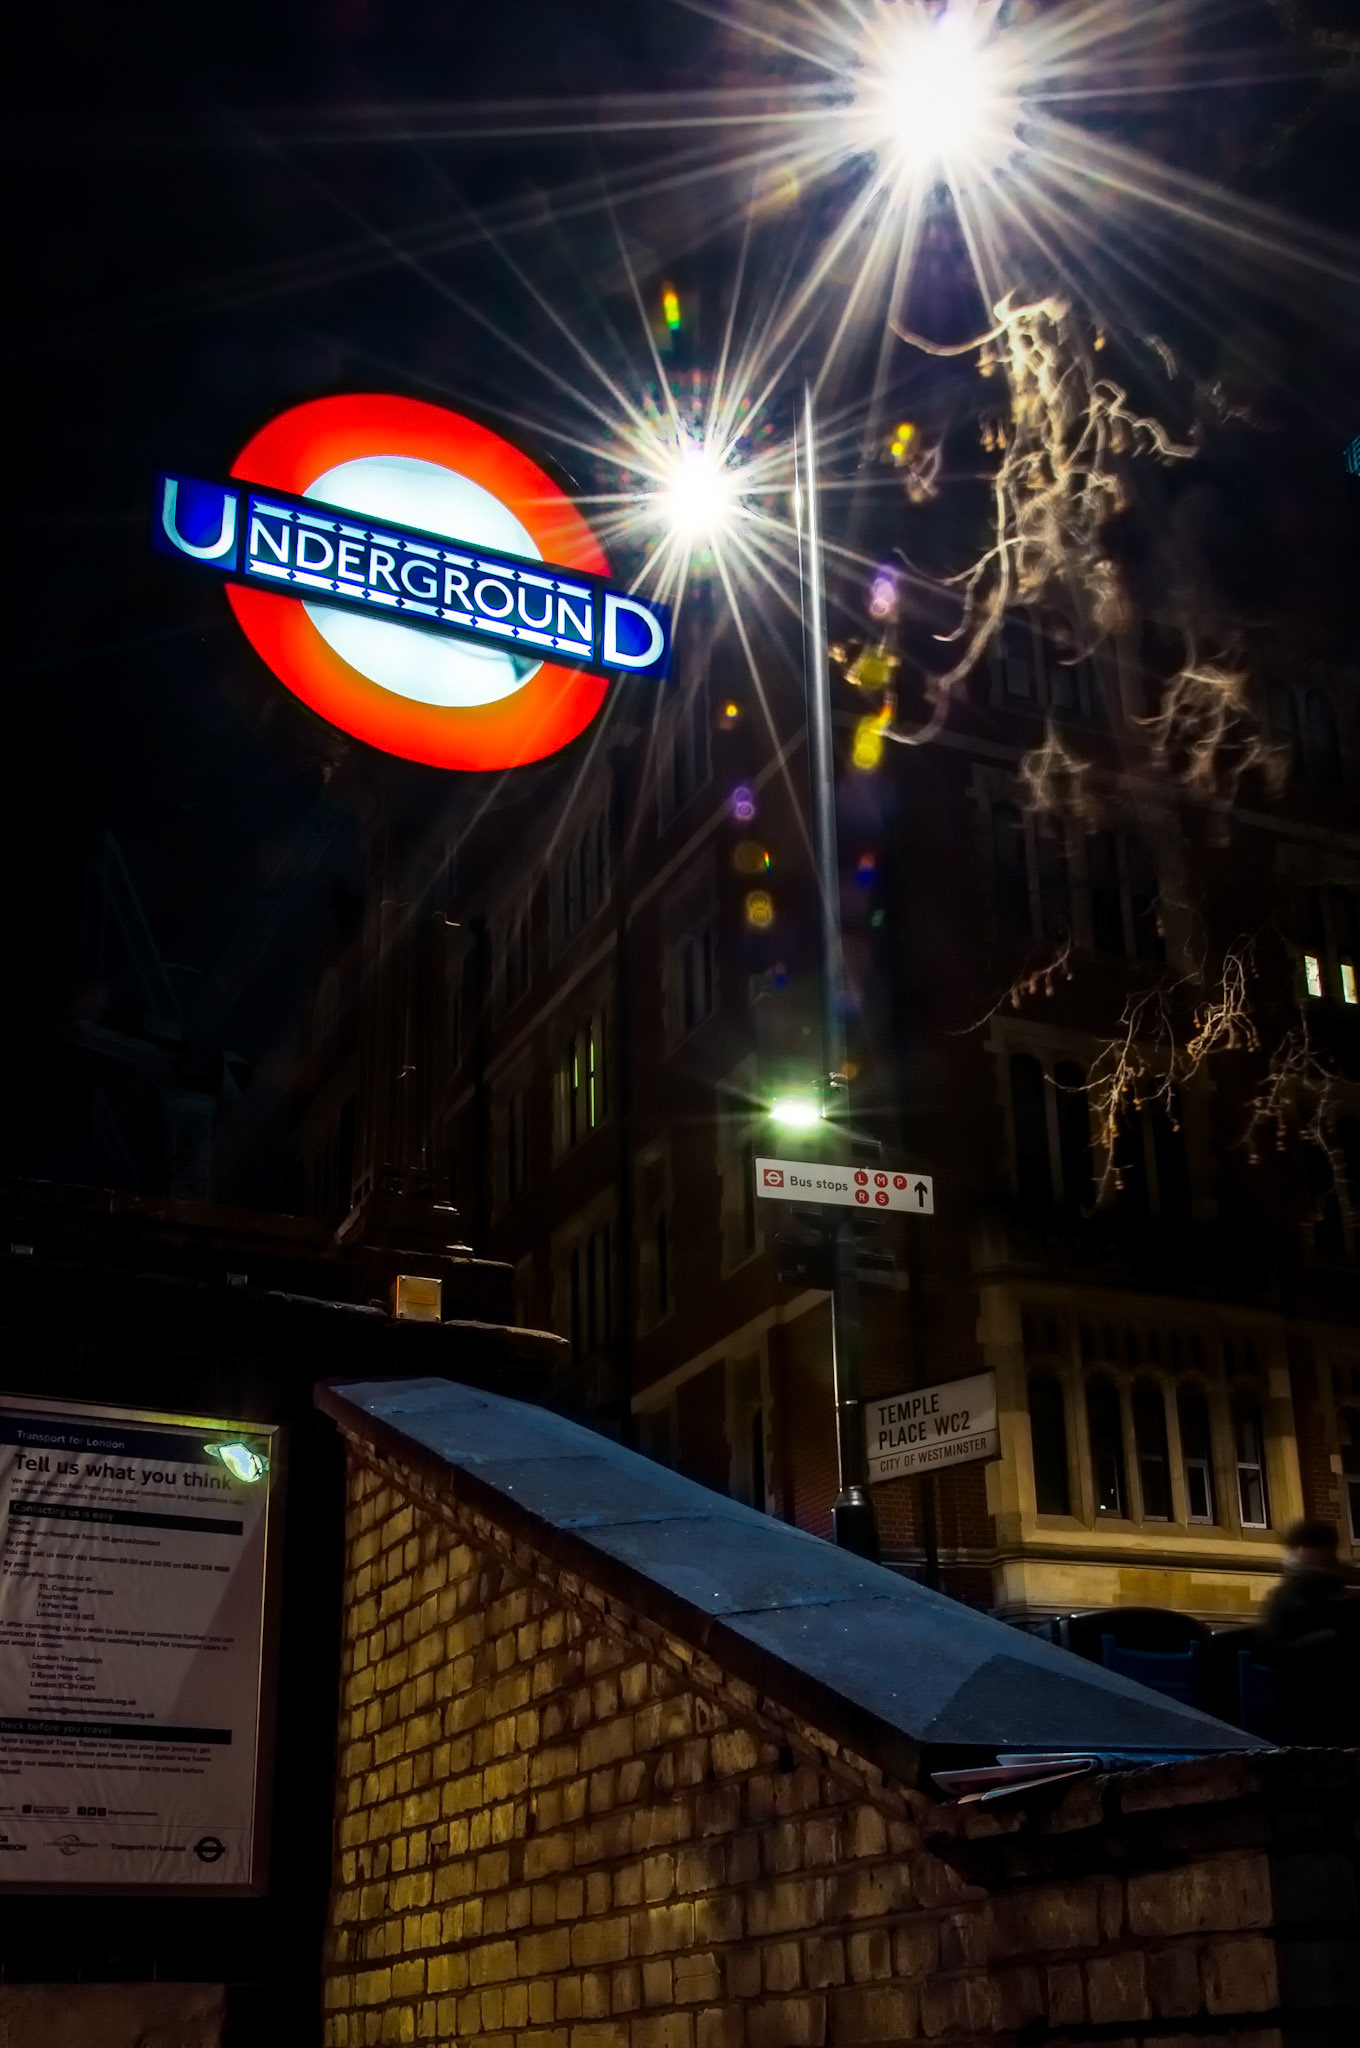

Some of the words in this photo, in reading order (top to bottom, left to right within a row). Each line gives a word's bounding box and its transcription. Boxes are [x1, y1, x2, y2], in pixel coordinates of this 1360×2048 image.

[161, 477, 666, 669] UNDERGROUND
[789, 1175, 812, 1188] Bus
[816, 1179, 849, 1193] stops
[878, 1393, 940, 1426] TEMPLE
[16, 1429, 66, 1445] Transport
[68, 1435, 84, 1445] for
[86, 1438, 126, 1449] London
[879, 1421, 927, 1450] PLACE
[934, 1410, 971, 1437] WC2
[880, 1457, 901, 1472] CITY
[904, 1454, 916, 1468] OF
[918, 1437, 987, 1464] WESTMINSTER
[15, 1454, 51, 1473] Tell
[57, 1461, 80, 1475] us
[85, 1462, 137, 1481] what
[140, 1469, 177, 1487] you
[183, 1470, 233, 1492] think
[13, 1504, 68, 1519] Contacting
[68, 1509, 81, 1517] us
[26, 1722, 61, 1732] before
[63, 1725, 81, 1735] you
[83, 1725, 113, 1735] travel
